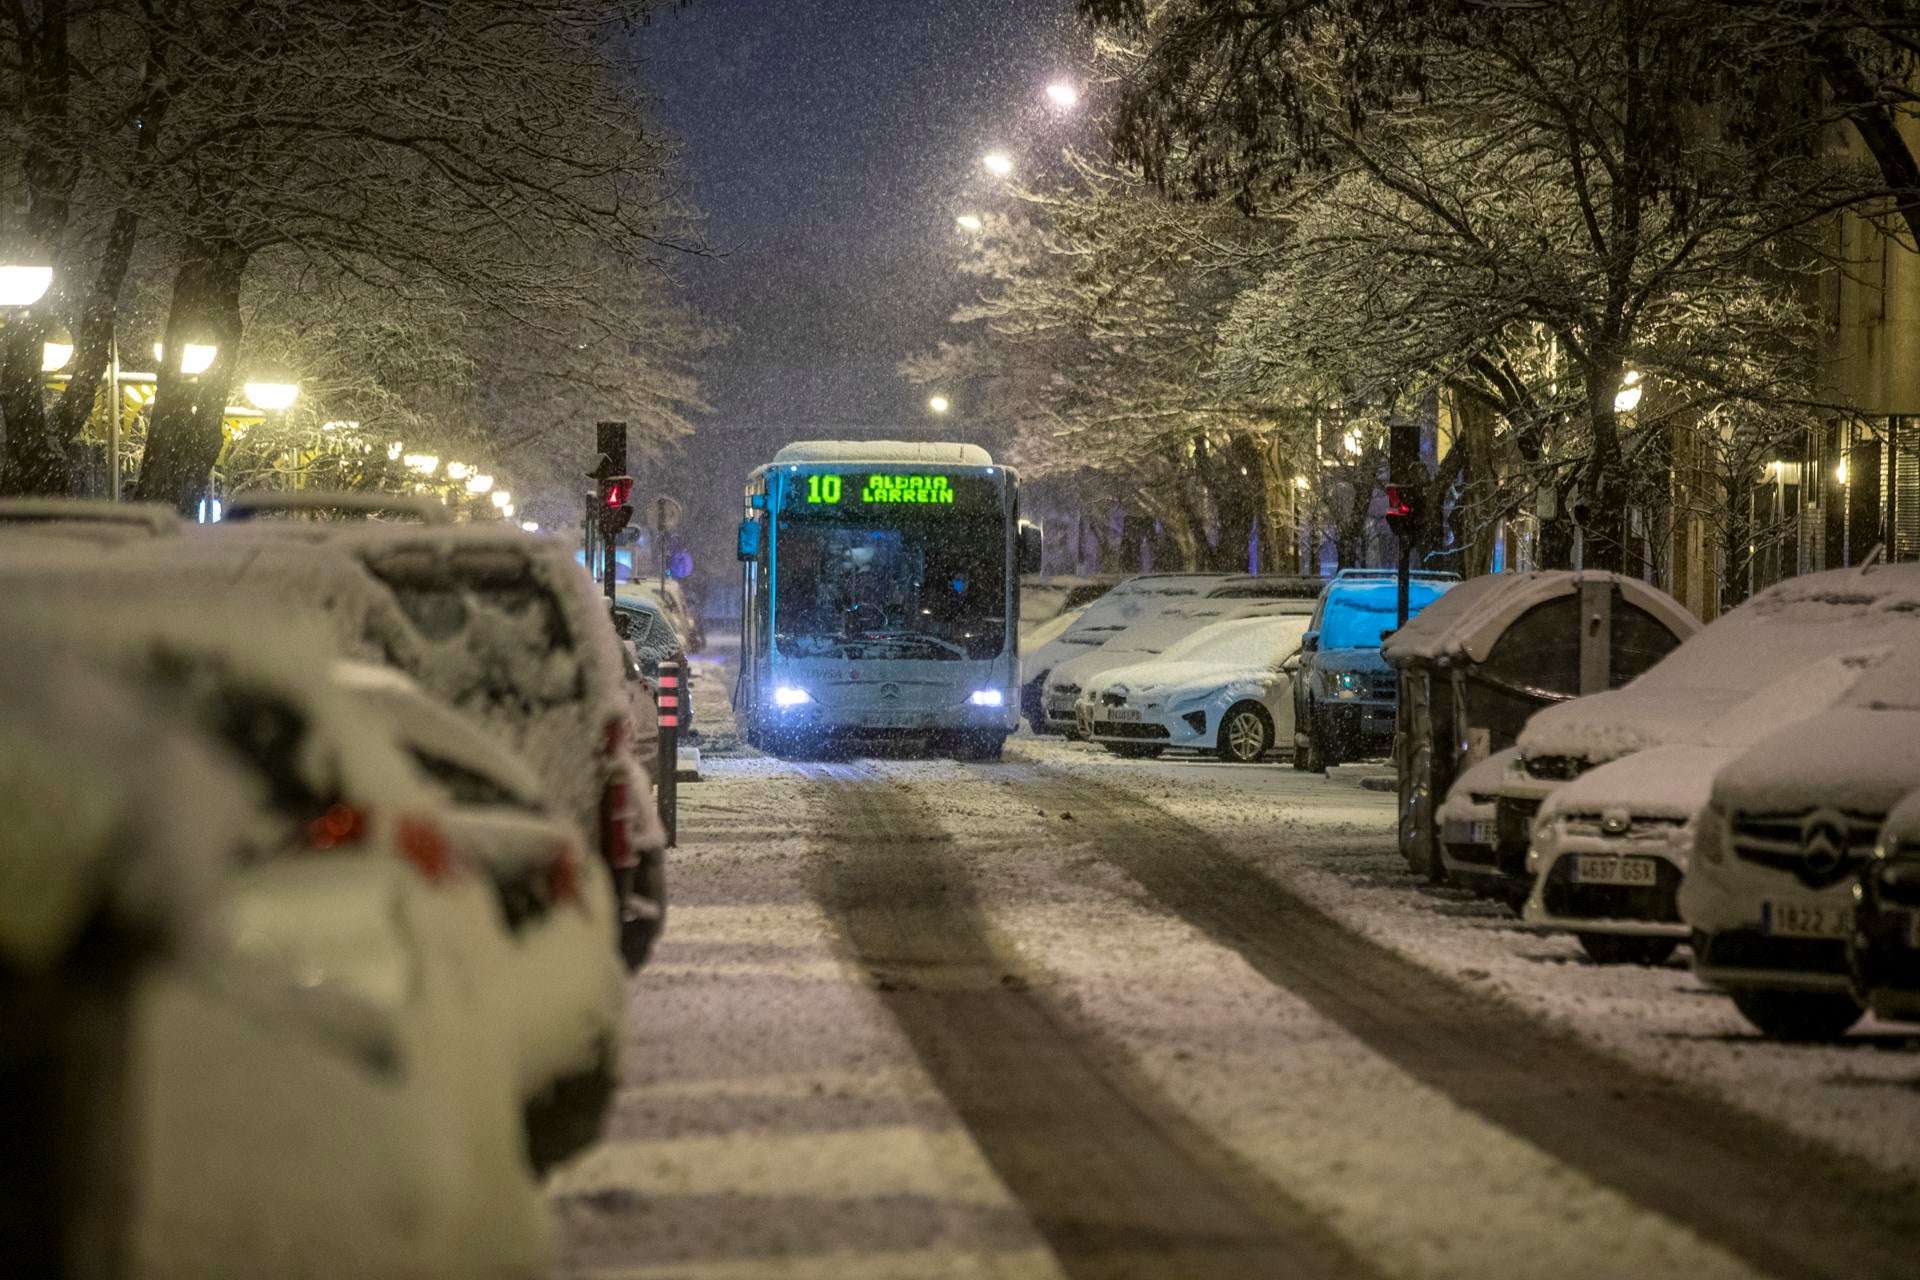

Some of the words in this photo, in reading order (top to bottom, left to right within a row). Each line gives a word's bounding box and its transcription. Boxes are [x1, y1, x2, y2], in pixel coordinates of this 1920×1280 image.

[807, 475, 842, 503] 10
[869, 475, 948, 489] ALDAIA
[863, 488, 953, 503] LARREIN
